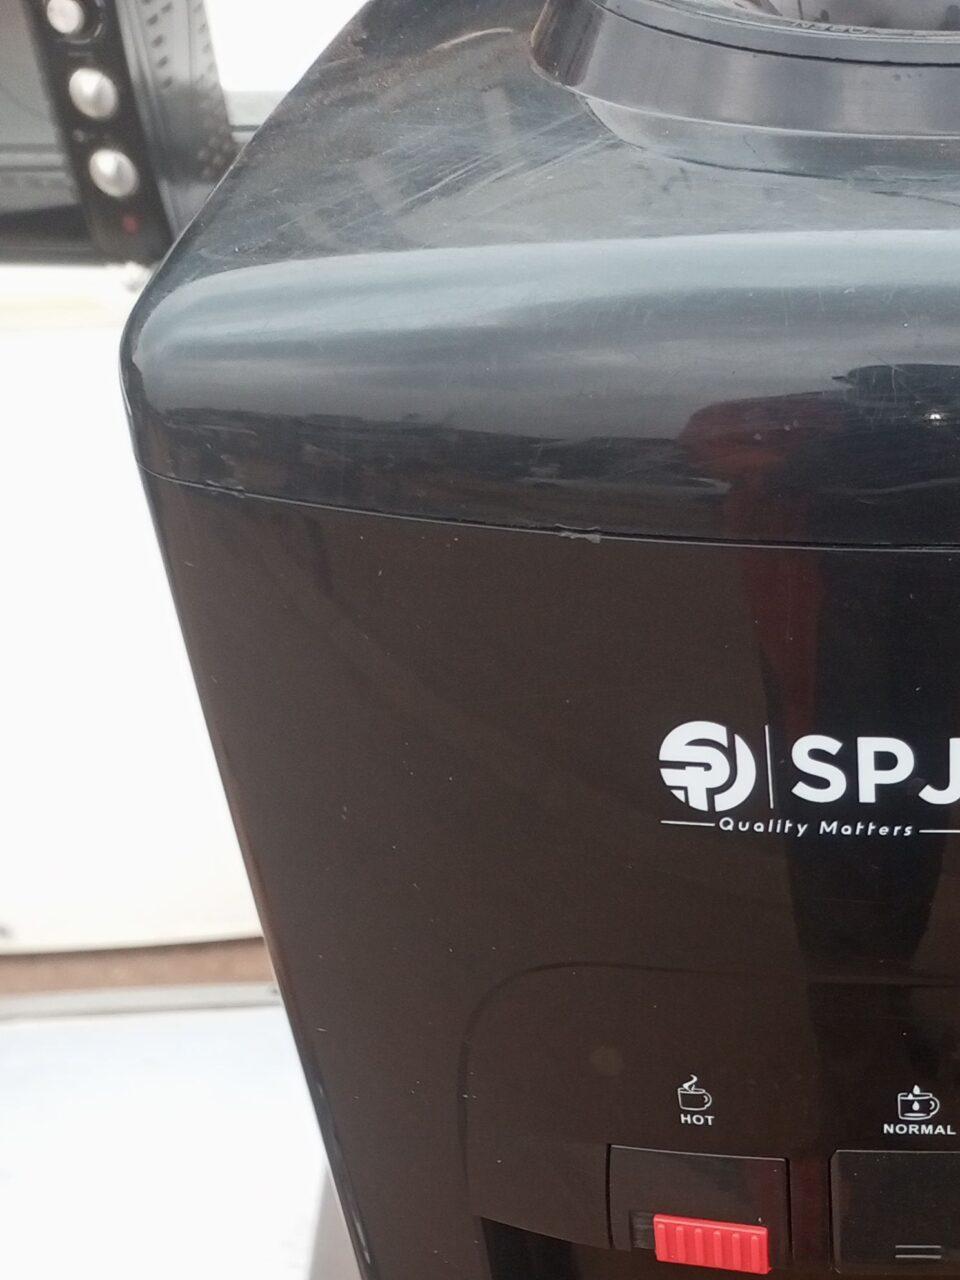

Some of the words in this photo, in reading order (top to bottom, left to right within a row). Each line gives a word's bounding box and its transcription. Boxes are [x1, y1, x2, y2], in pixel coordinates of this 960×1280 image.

[718, 817, 808, 837] Quality
[819, 820, 913, 837] Matters
[680, 1113, 715, 1126] HOT
[883, 1123, 957, 1136] NORMAL
